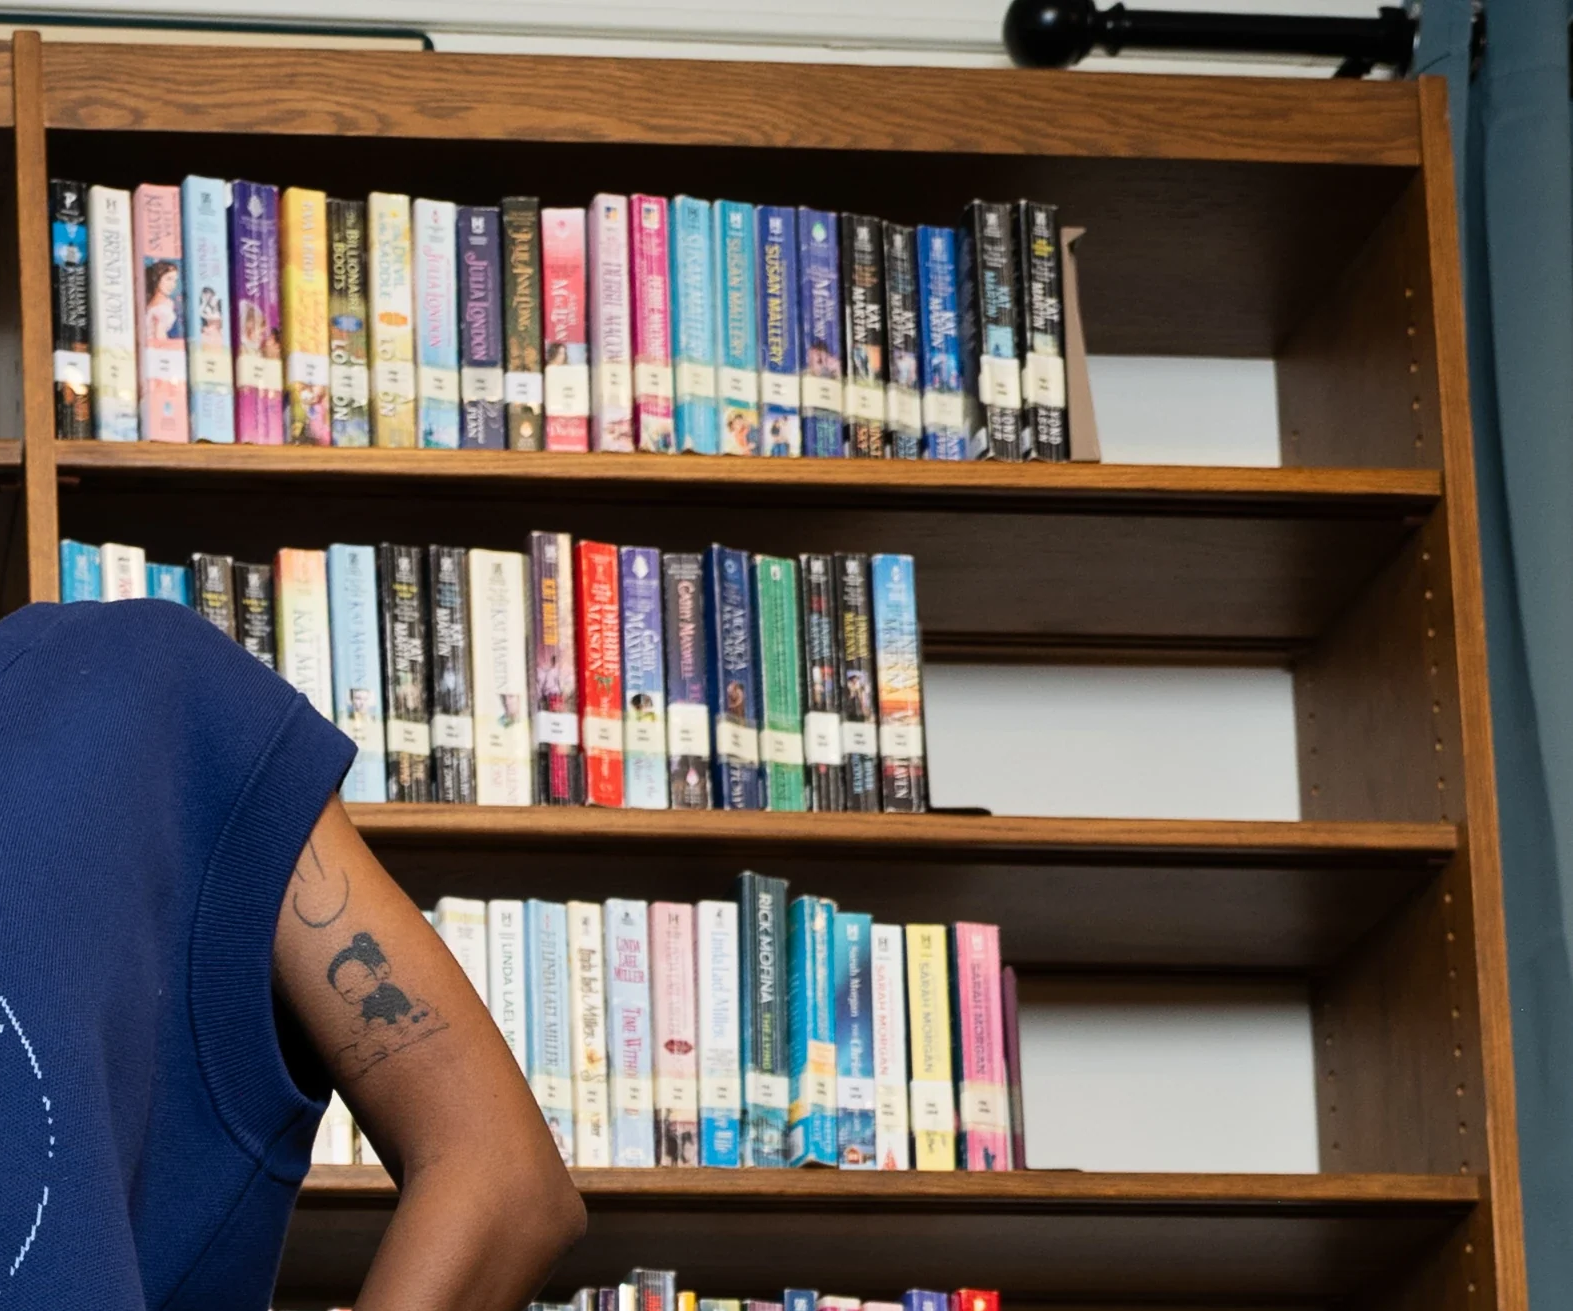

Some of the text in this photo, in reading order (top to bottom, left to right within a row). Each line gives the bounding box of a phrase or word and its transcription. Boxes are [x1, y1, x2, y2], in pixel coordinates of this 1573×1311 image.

[465, 252, 490, 361] JULIA LONDON
[764, 243, 784, 365] SUSAN MALLERY
[587, 603, 602, 671] MASON
[603, 604, 620, 676] DEBBIE
[758, 892, 774, 1004] RICK MOFINA
[919, 961, 934, 1073] SARAH MORGAN
